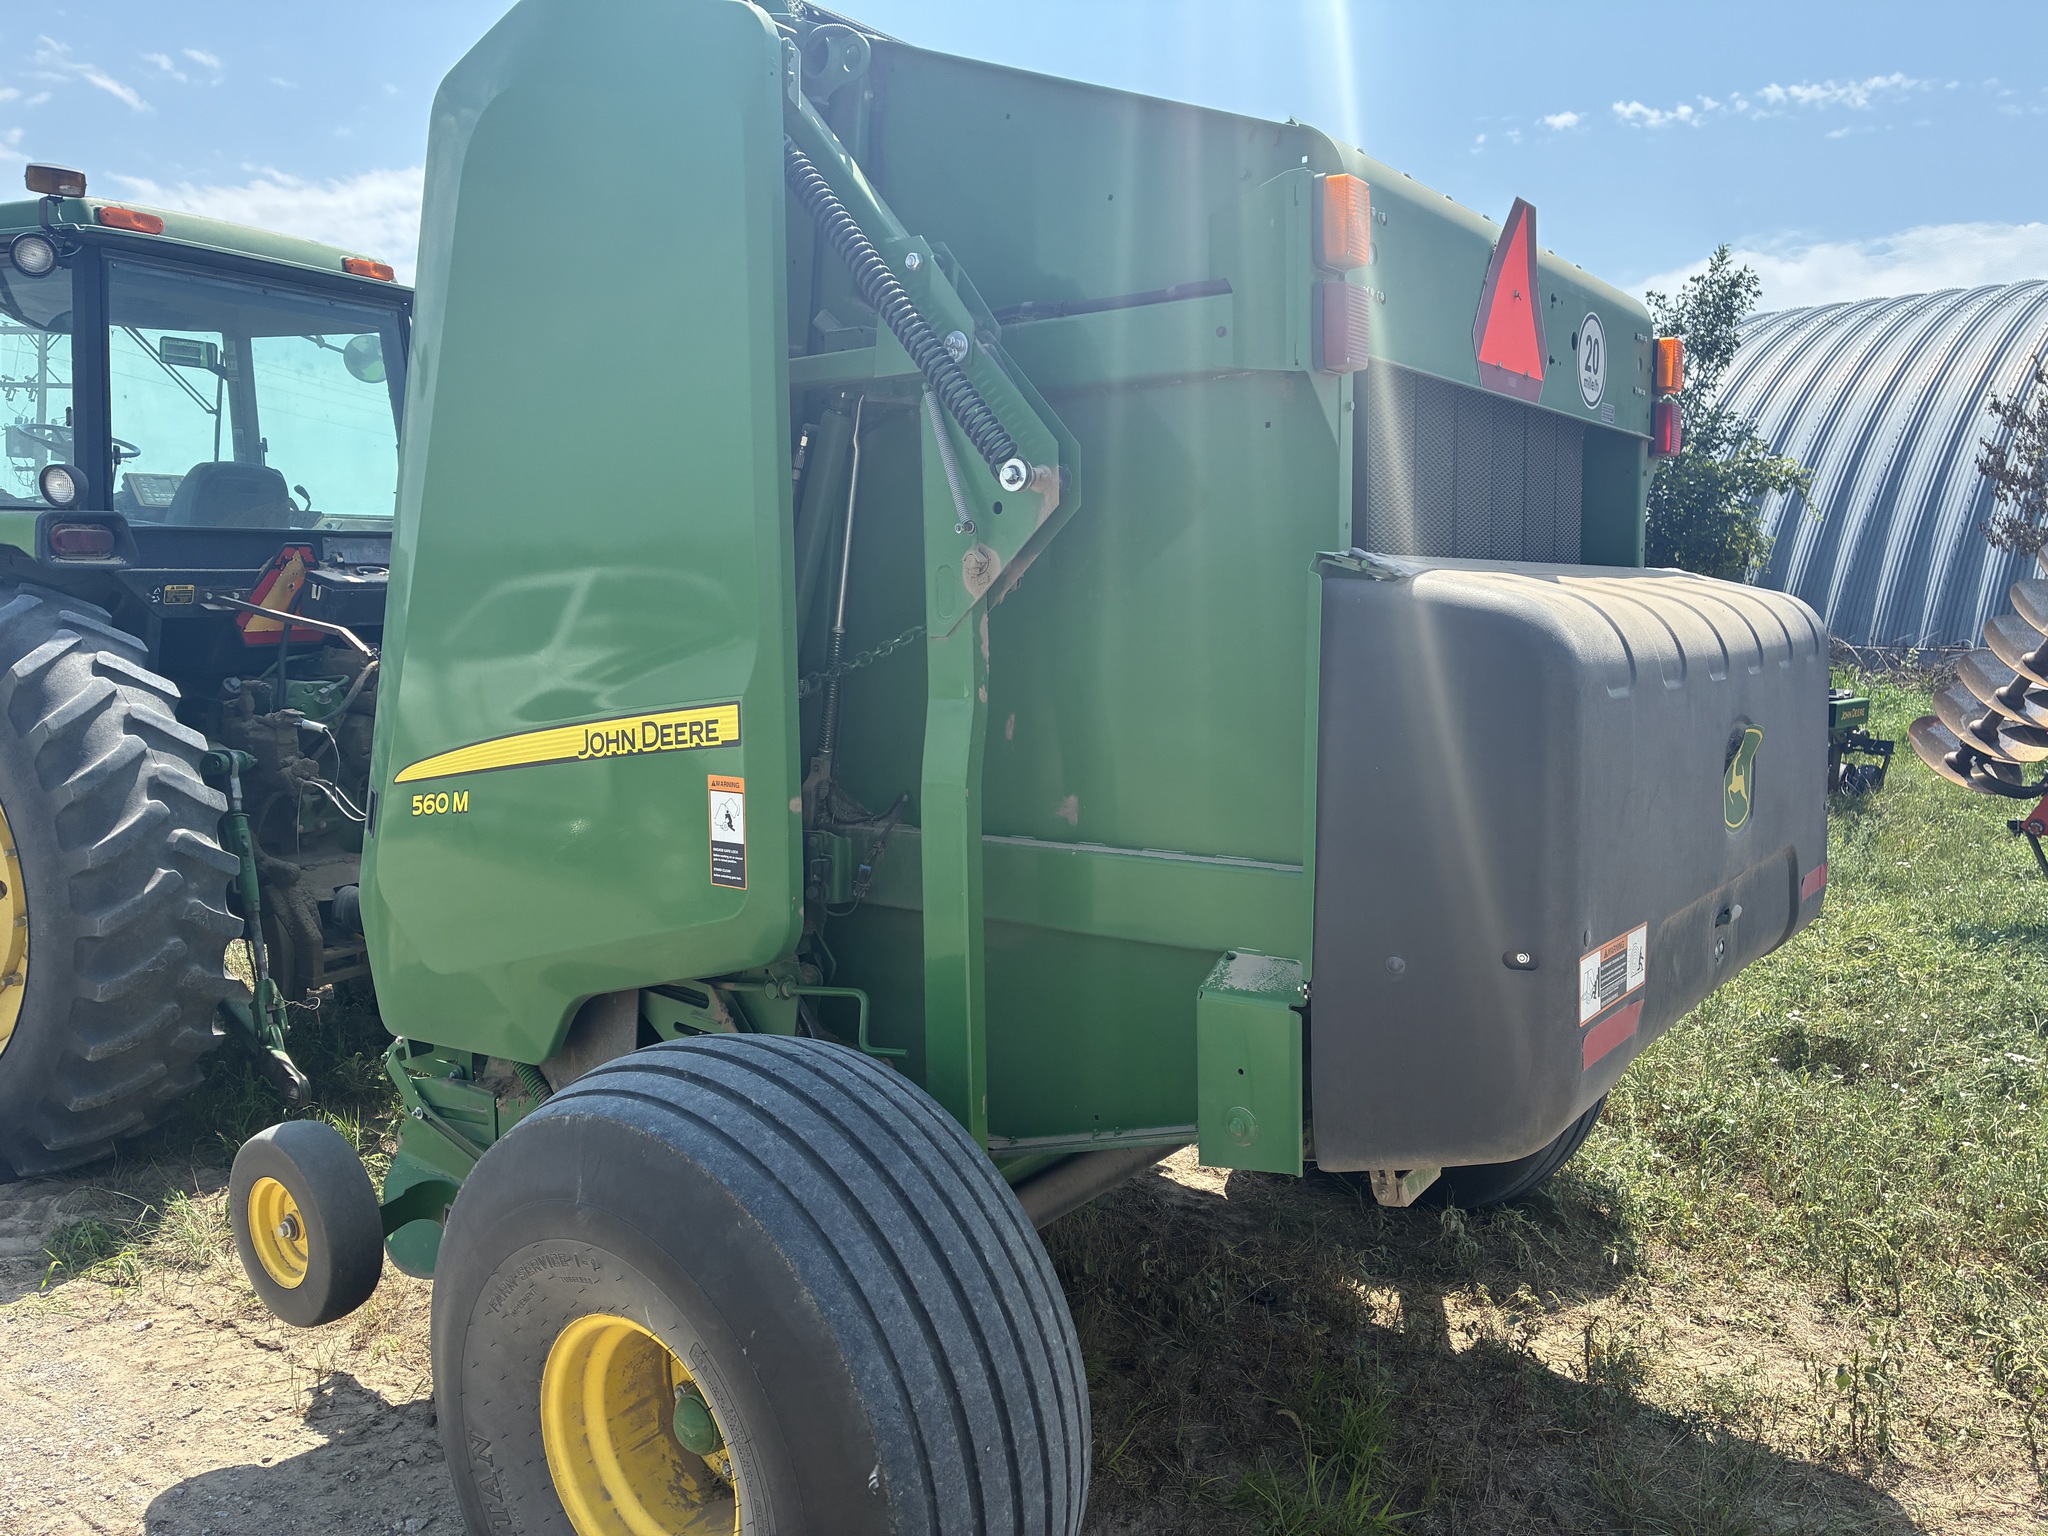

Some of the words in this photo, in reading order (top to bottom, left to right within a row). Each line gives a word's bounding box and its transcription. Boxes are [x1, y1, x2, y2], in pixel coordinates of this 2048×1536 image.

[1584, 334, 1599, 375] 20
[577, 727, 637, 758] JOHN
[641, 718, 720, 750] DEERE
[715, 780, 740, 789] WARNING
[411, 792, 450, 817] 560
[452, 789, 469, 813] M
